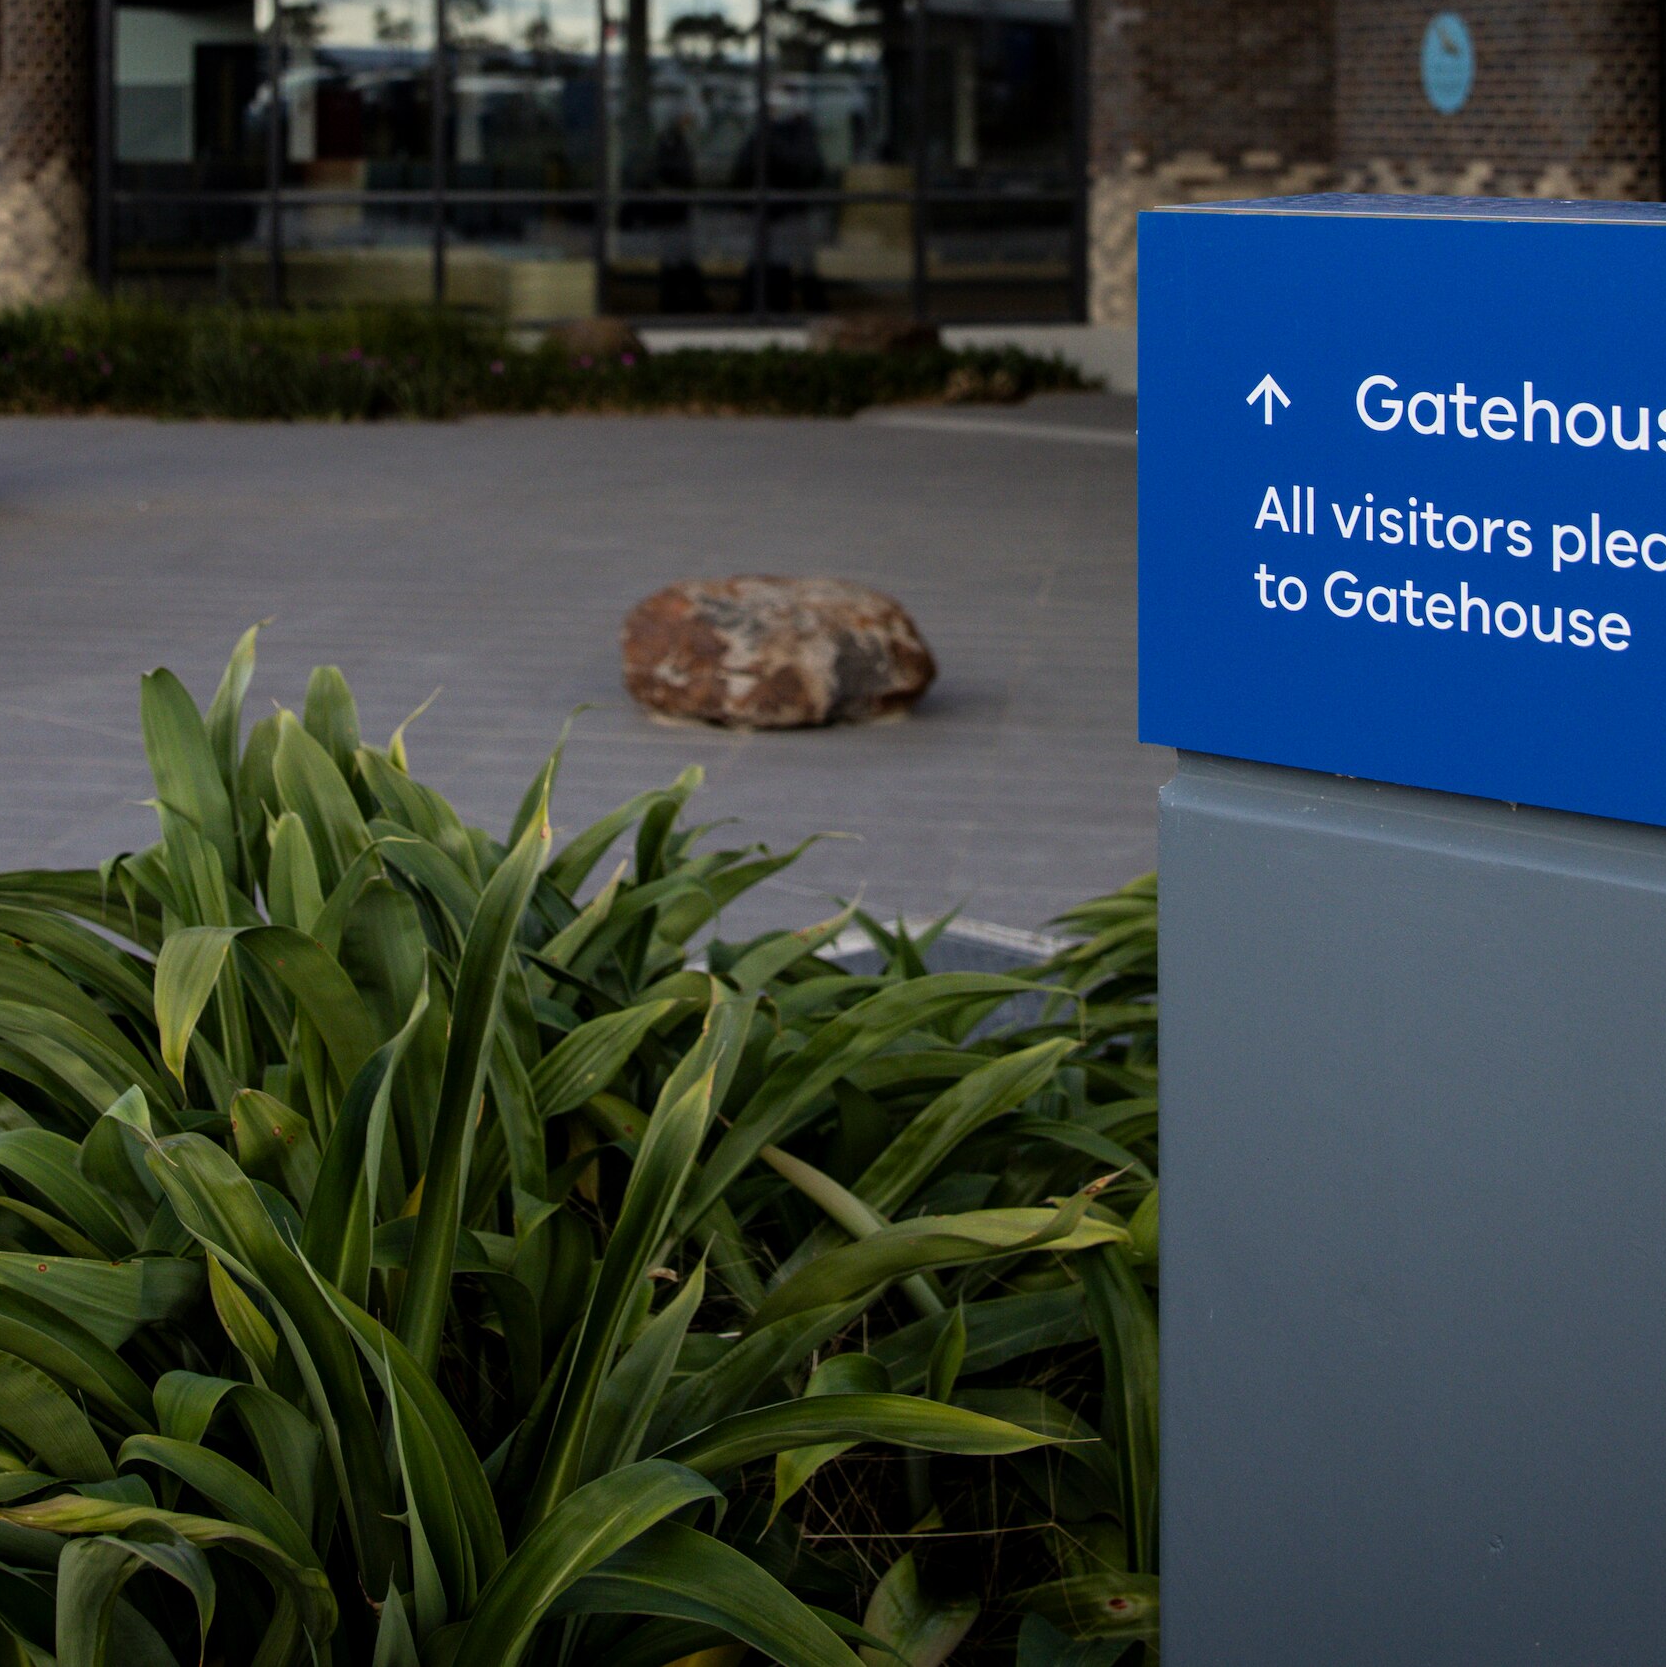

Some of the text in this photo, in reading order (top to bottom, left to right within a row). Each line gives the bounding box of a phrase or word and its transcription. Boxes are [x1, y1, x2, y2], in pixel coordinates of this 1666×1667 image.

[1253, 485, 1316, 536] All
[1330, 491, 1534, 559] visitors
[1252, 562, 1633, 653] to Gatehouse
